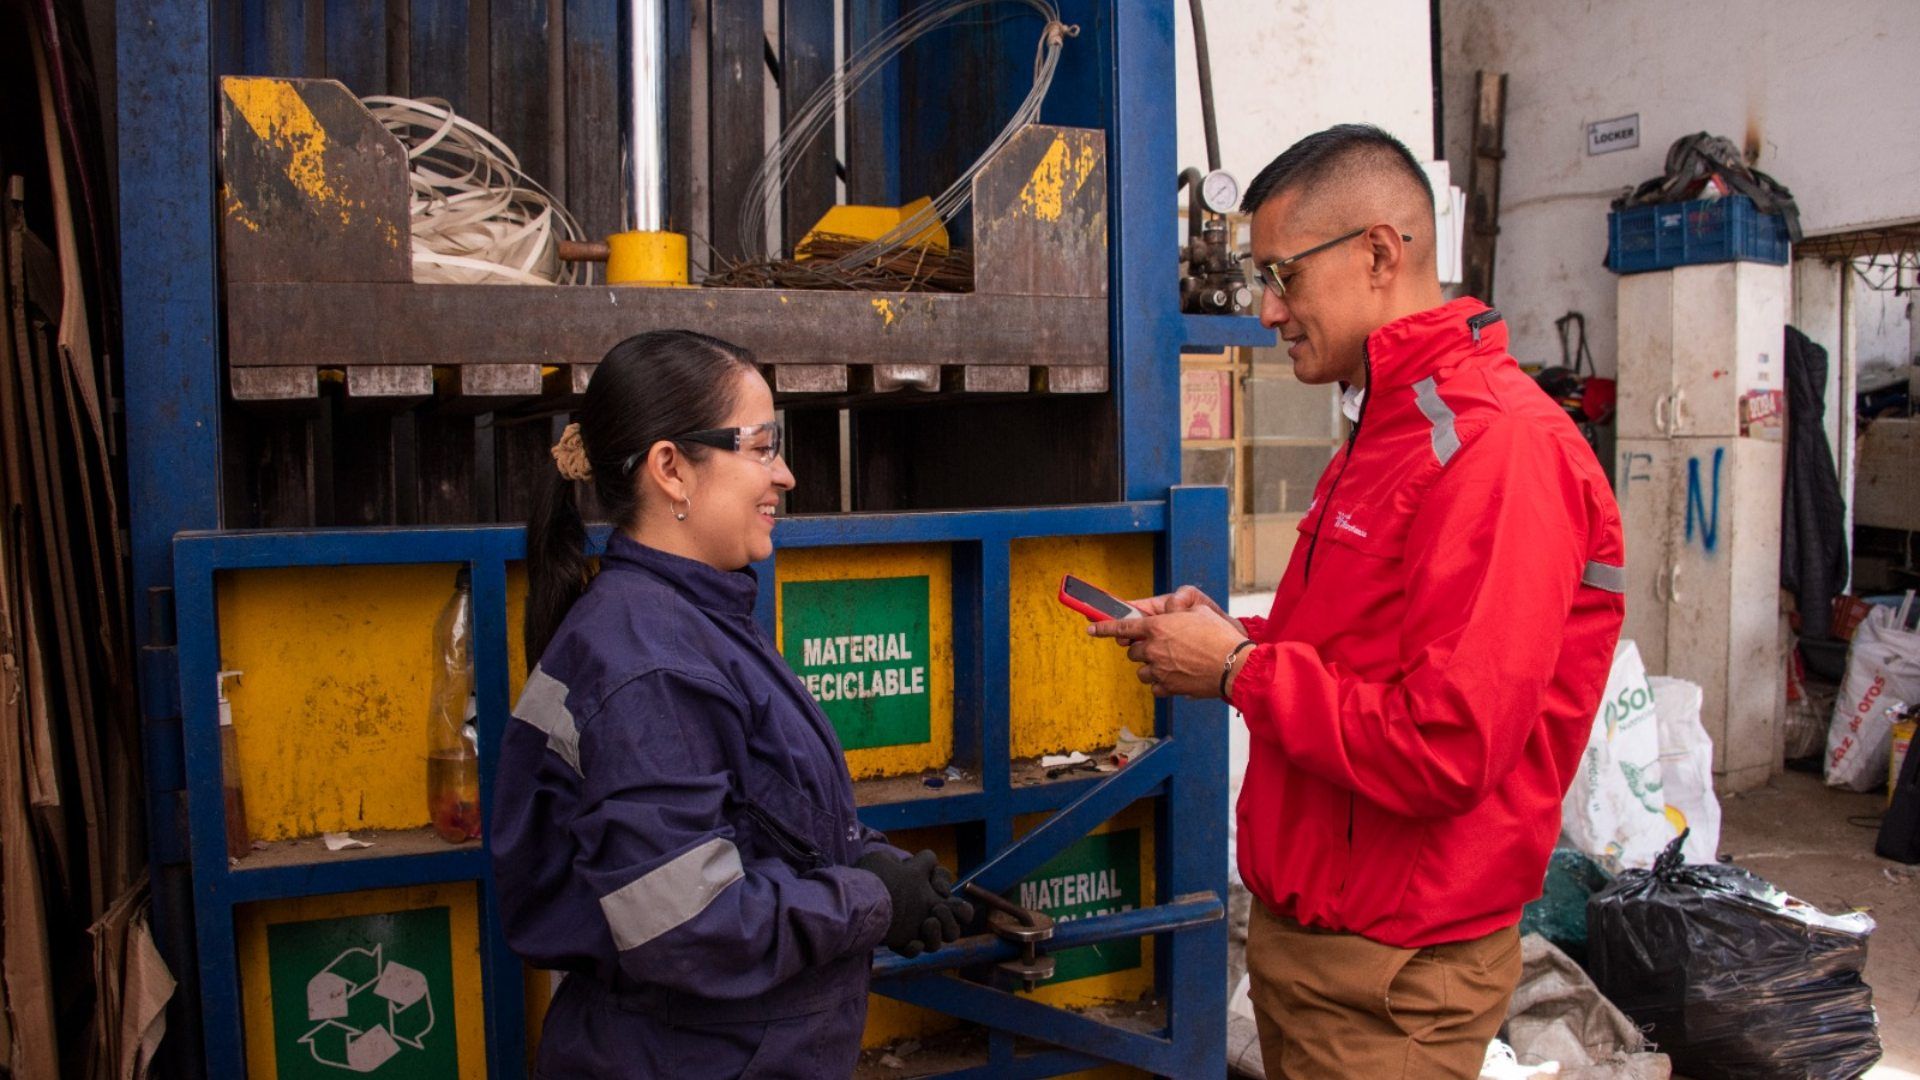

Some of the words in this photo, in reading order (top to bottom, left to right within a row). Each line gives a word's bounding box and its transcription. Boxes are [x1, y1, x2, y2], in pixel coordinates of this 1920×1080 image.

[1594, 127, 1634, 144] LOCKER
[1685, 446, 1724, 554] N
[803, 632, 912, 667] MATERIAL
[1020, 868, 1122, 911] MATERIAL
